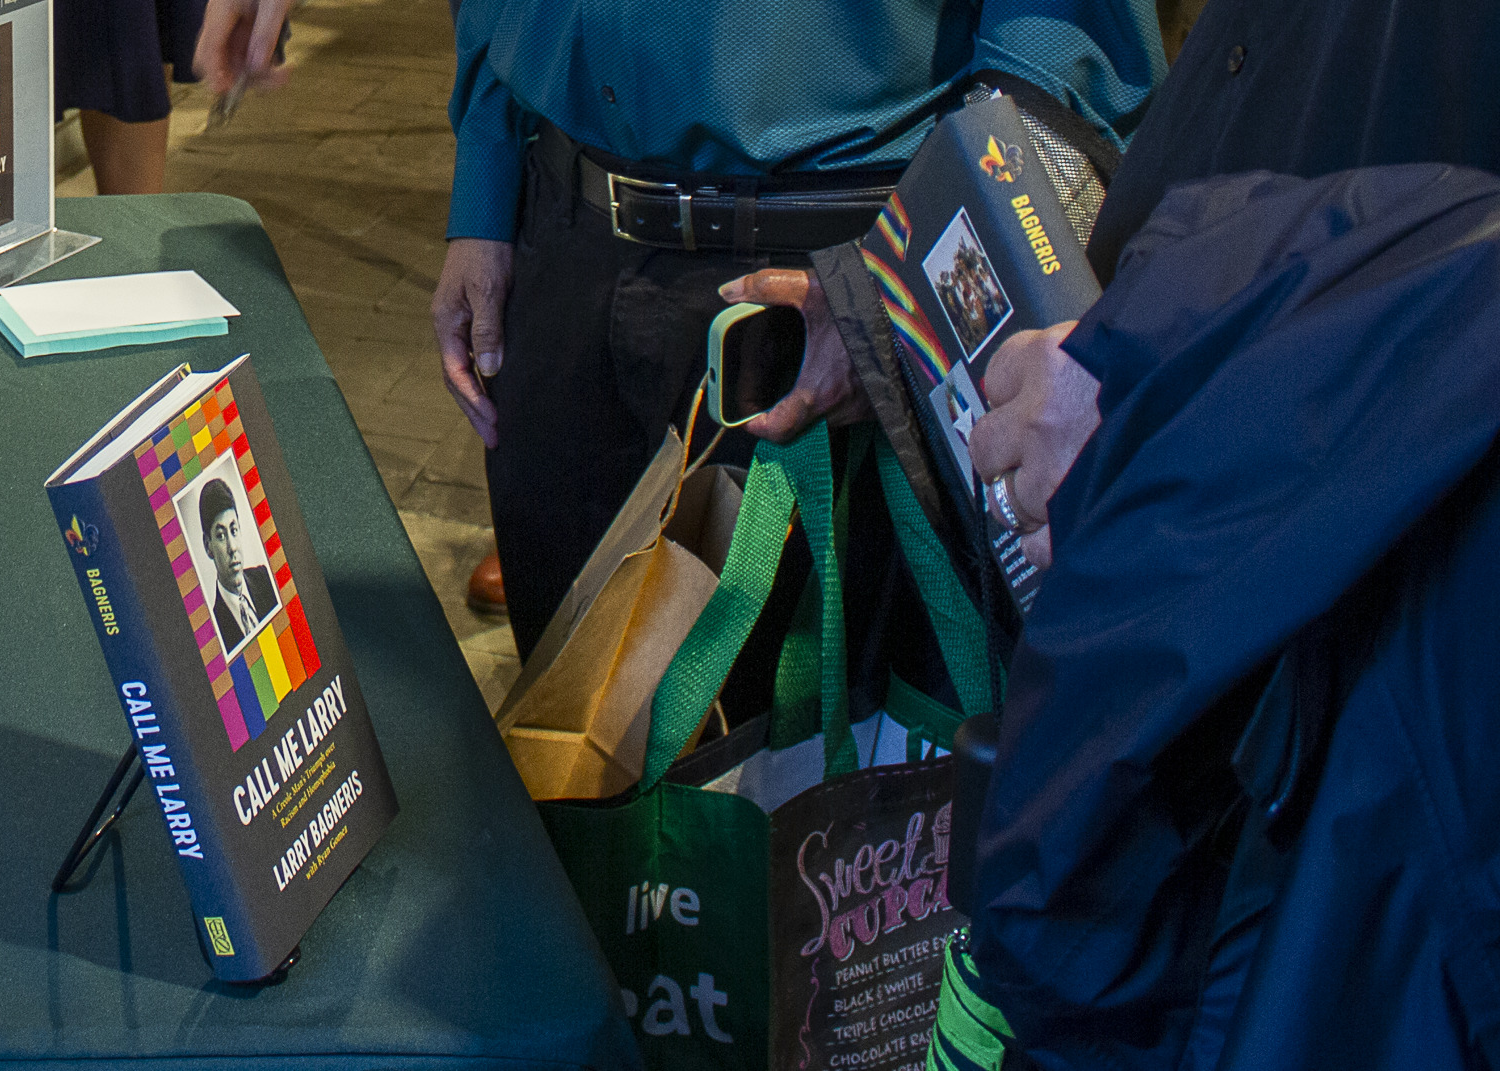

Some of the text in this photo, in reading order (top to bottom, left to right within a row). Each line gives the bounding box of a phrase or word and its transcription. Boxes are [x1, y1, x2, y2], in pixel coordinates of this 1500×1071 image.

[1011, 194, 1061, 275] BAGNERIS
[86, 568, 120, 635] BAGNERIS
[122, 681, 203, 860] CALL ME LARRY
[233, 675, 347, 825] CALL ME LARRY
[276, 791, 292, 815] Creole
[291, 774, 306, 796] Man's
[304, 750, 326, 781] Triumph
[325, 742, 336, 757] over
[281, 761, 336, 829] Racism and Homophobia
[273, 770, 363, 892] LARRY BAGNERIS
[305, 825, 348, 880] with Ryan Gomez
[626, 880, 700, 935] live
[797, 812, 926, 956] Sweet
[833, 988, 874, 1013] BLACK
[884, 972, 924, 996] WHITE
[835, 958, 880, 986] PEANUT
[882, 941, 931, 966] BUTTER
[829, 1035, 908, 1068] CHOCOLATE
[833, 1018, 878, 1041] TRIPLE
